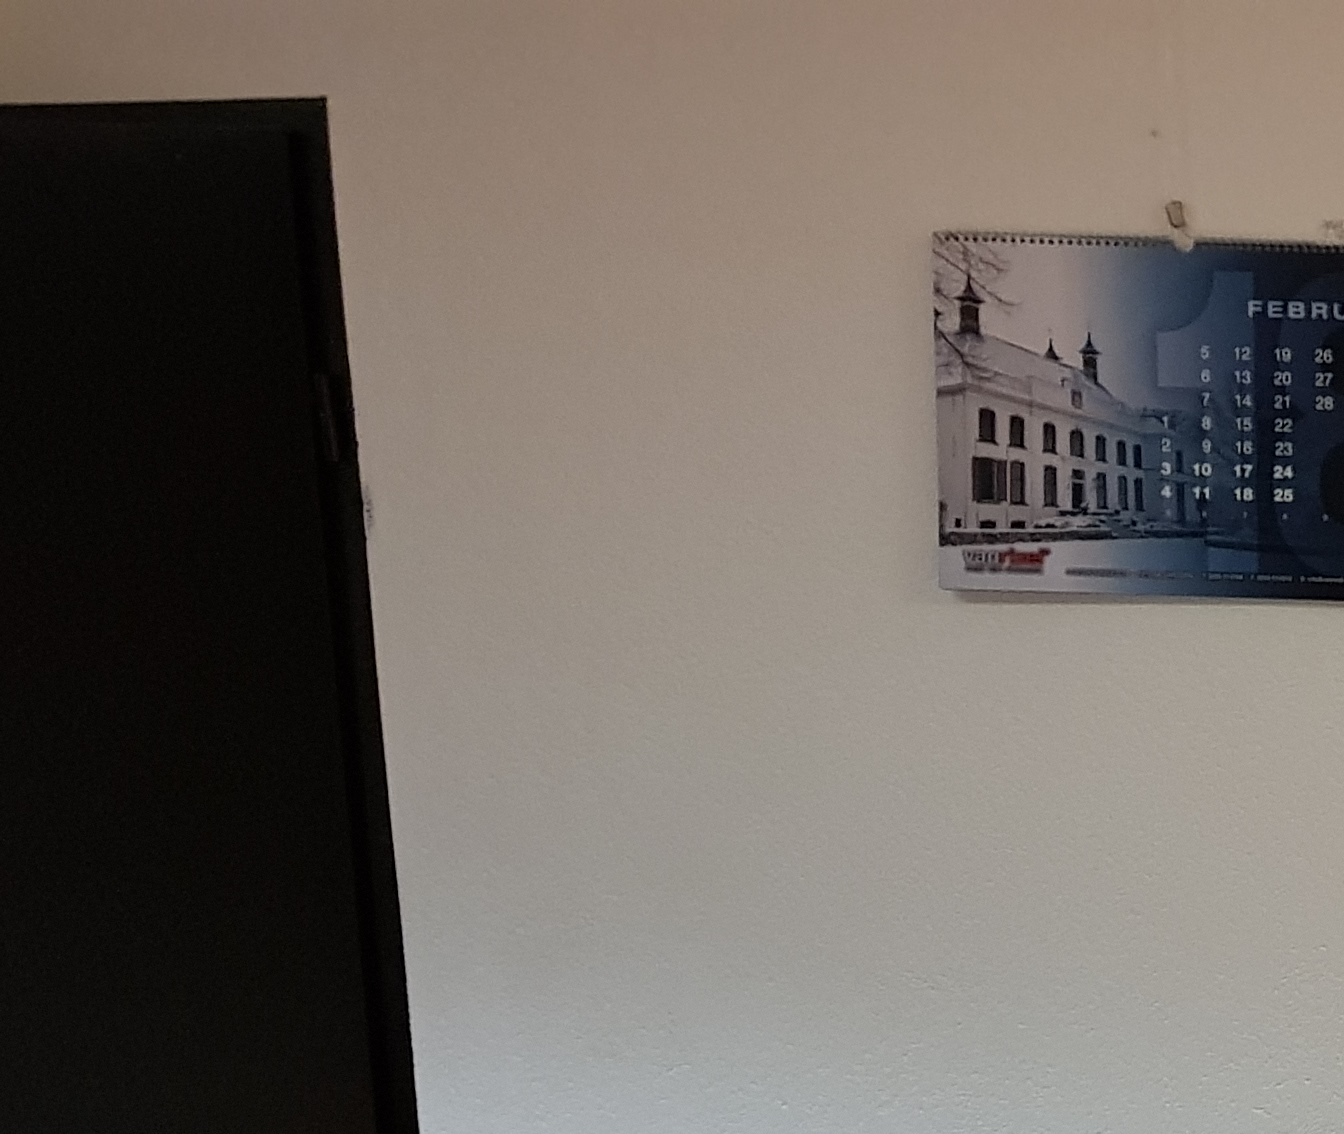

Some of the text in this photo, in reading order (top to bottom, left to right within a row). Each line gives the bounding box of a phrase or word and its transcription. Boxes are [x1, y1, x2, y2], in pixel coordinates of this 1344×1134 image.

[1201, 346, 1210, 360] 5
[1234, 347, 1251, 361] 12
[1274, 349, 1291, 362] 19
[1314, 349, 1333, 363] 26
[1201, 370, 1211, 383] 6
[1234, 371, 1251, 384] 13
[1273, 372, 1291, 386] 20
[1315, 373, 1333, 387] 27
[1202, 393, 1211, 406] 7
[1234, 395, 1252, 408] 14
[1274, 395, 1290, 408] 21
[1315, 397, 1334, 411] 28
[1161, 416, 1169, 428] 1
[1202, 417, 1211, 430] 8
[1235, 418, 1252, 432] 15
[1274, 419, 1293, 433] 22
[1161, 439, 1171, 452] 2
[1202, 439, 1211, 452] 9
[1235, 442, 1252, 455] 16
[1275, 443, 1293, 457] 23
[1161, 462, 1171, 475] 3
[1193, 463, 1212, 476] 10
[1234, 464, 1253, 478] 17
[1273, 465, 1293, 479] 24
[1161, 486, 1171, 499] 4
[1193, 487, 1210, 500] 11
[1234, 488, 1253, 502] 18
[1273, 489, 1293, 503] 25
